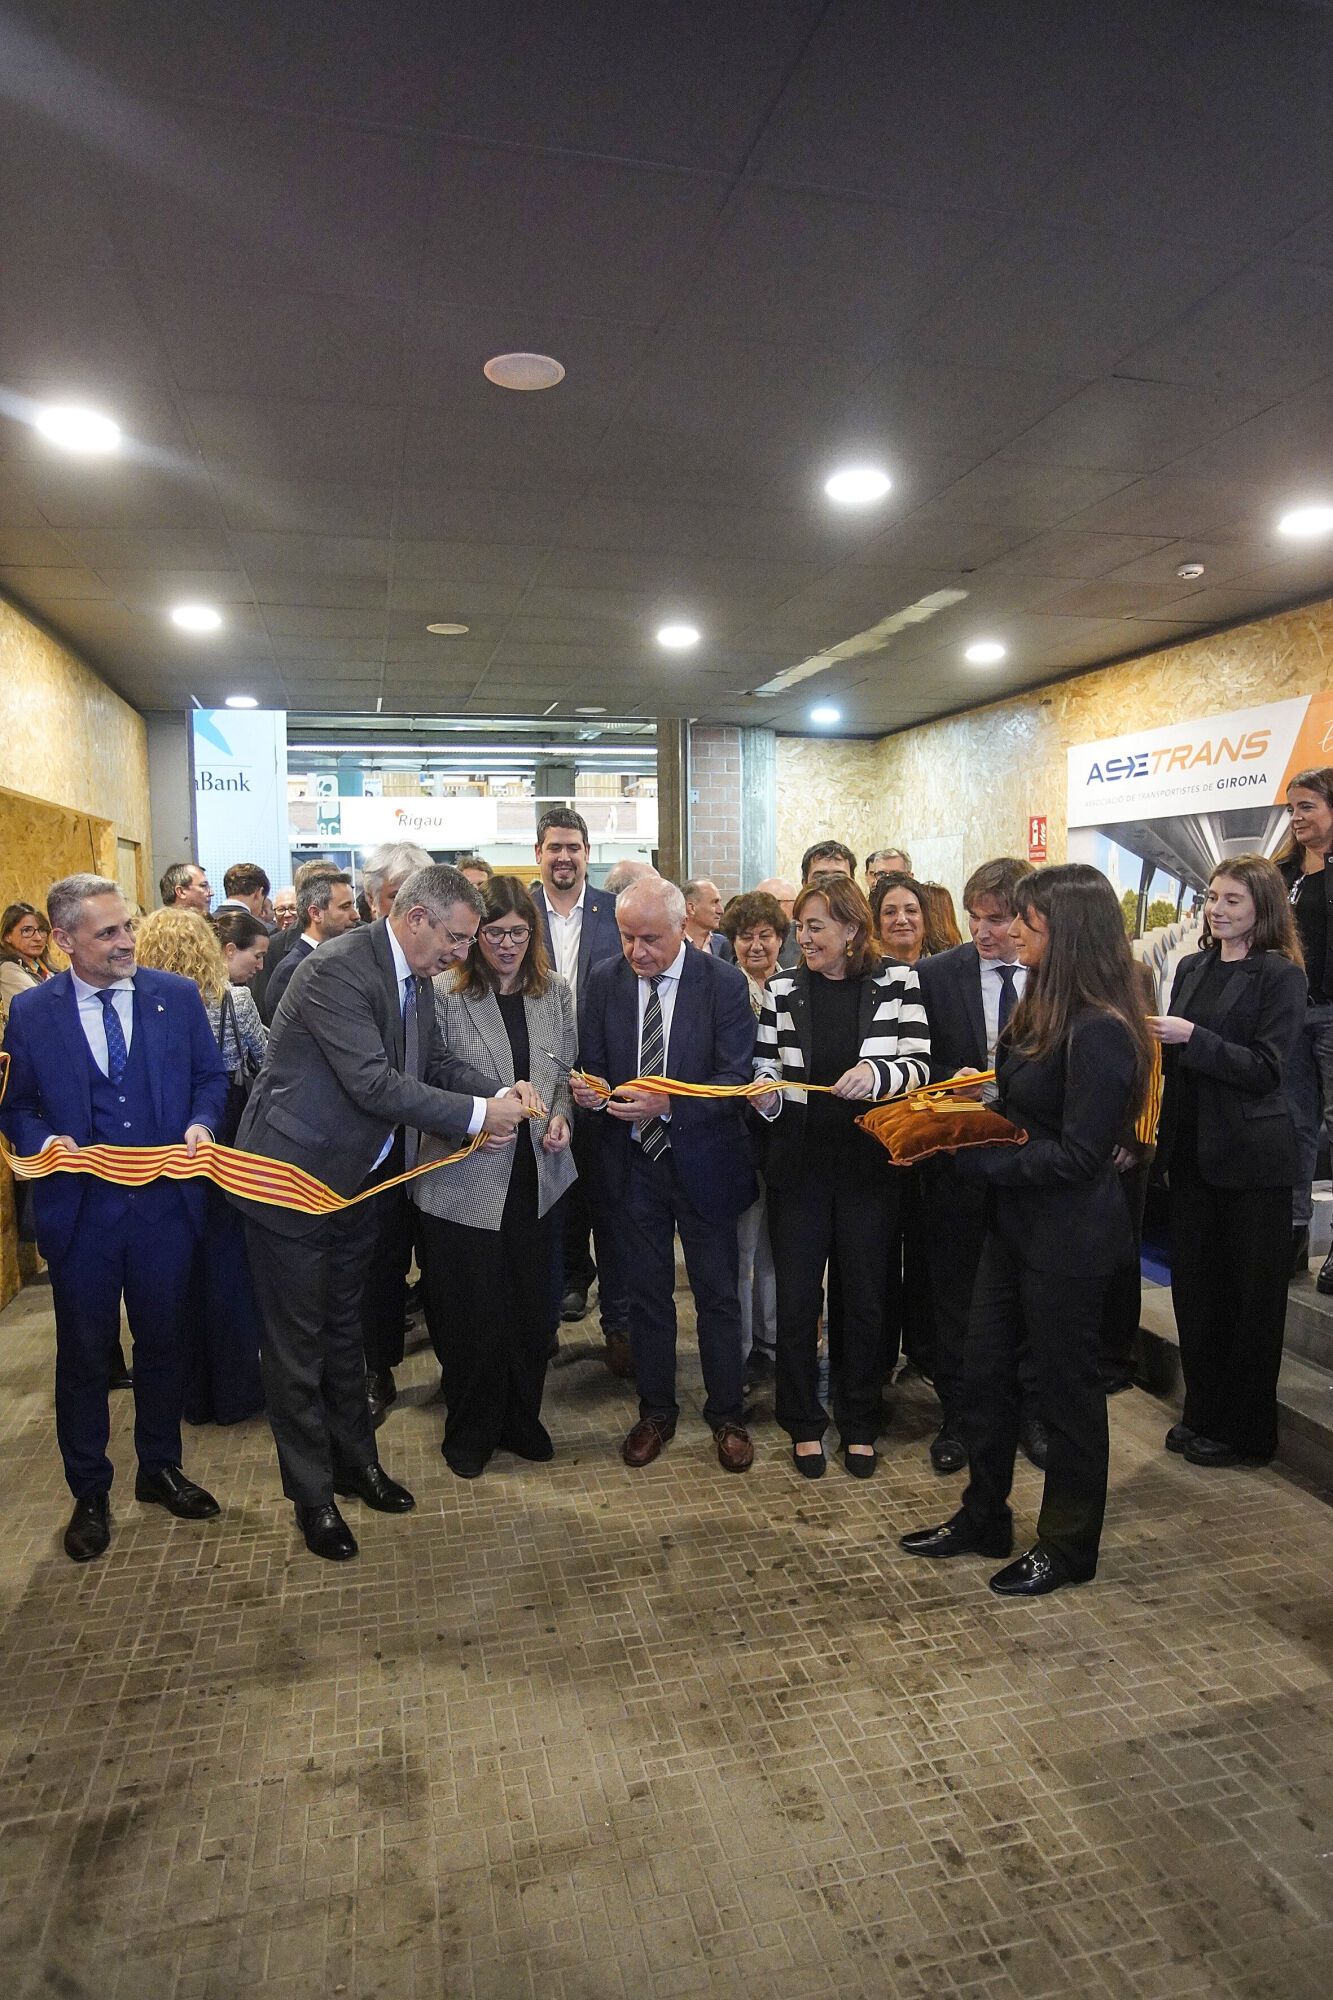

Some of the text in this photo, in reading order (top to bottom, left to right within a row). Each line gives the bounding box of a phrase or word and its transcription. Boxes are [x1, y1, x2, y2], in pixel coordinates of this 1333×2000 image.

[1086, 729, 1272, 786] ASETRANS
[1202, 783, 1213, 792] DE
[1216, 773, 1268, 790] GIRONA
[398, 814, 443, 830] Rigau
